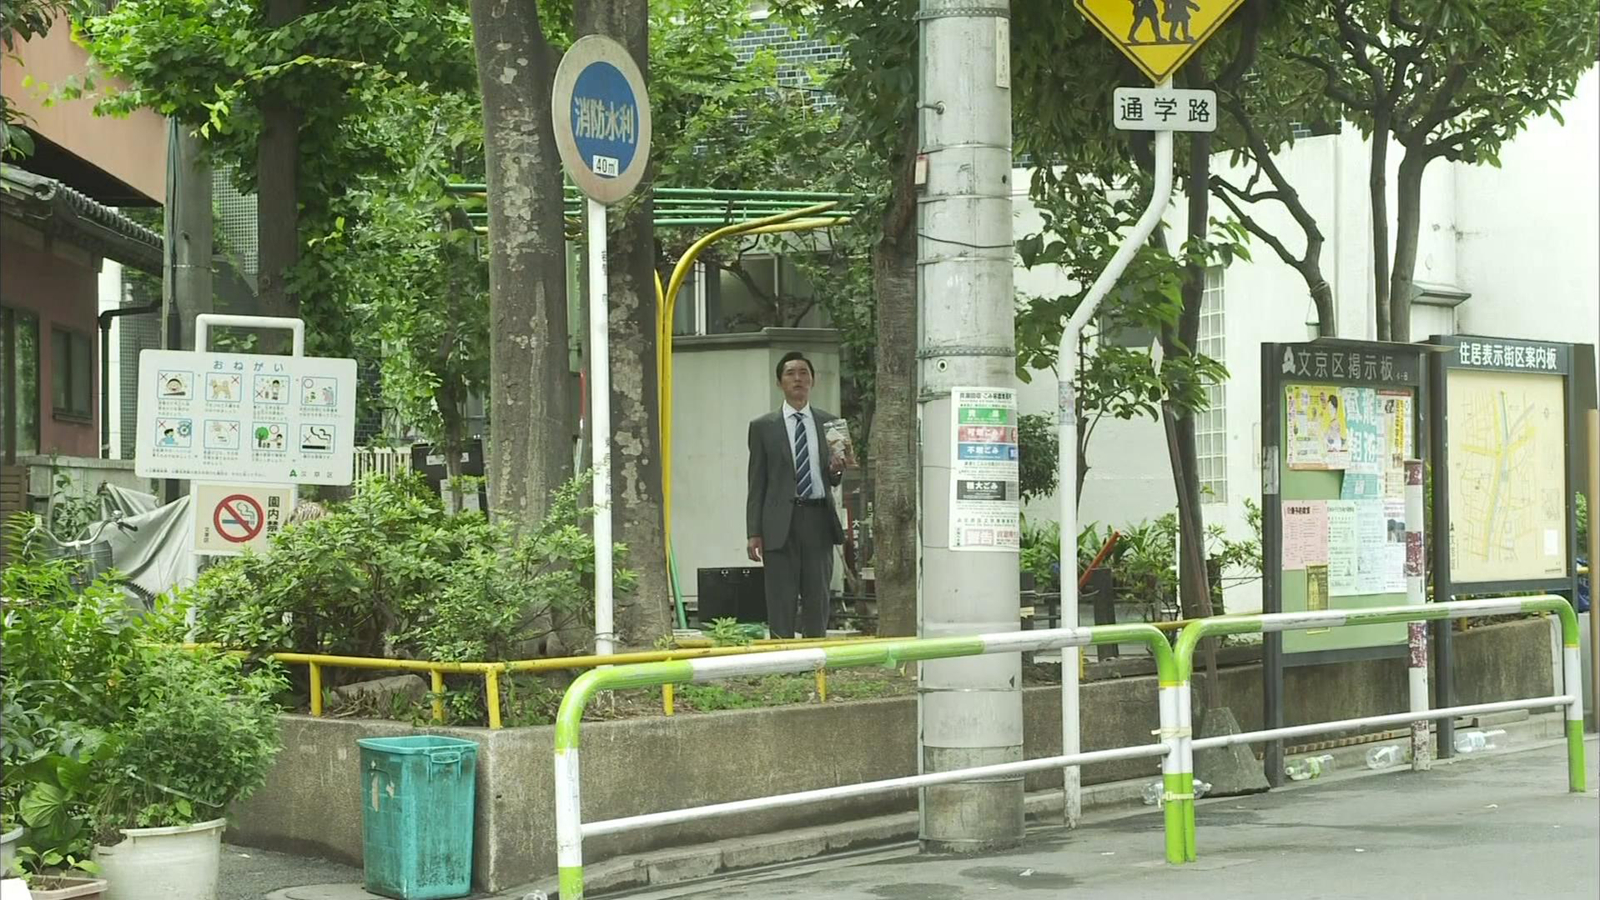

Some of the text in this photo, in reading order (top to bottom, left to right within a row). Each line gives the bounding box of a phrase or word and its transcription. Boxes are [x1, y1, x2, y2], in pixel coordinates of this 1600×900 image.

[574, 96, 634, 144] 消防水利
[1120, 97, 1210, 122] 通学路
[213, 359, 284, 373] おねがい
[1297, 350, 1394, 381] 文京区掲示板
[1459, 341, 1557, 370] 住居表示街区案内板
